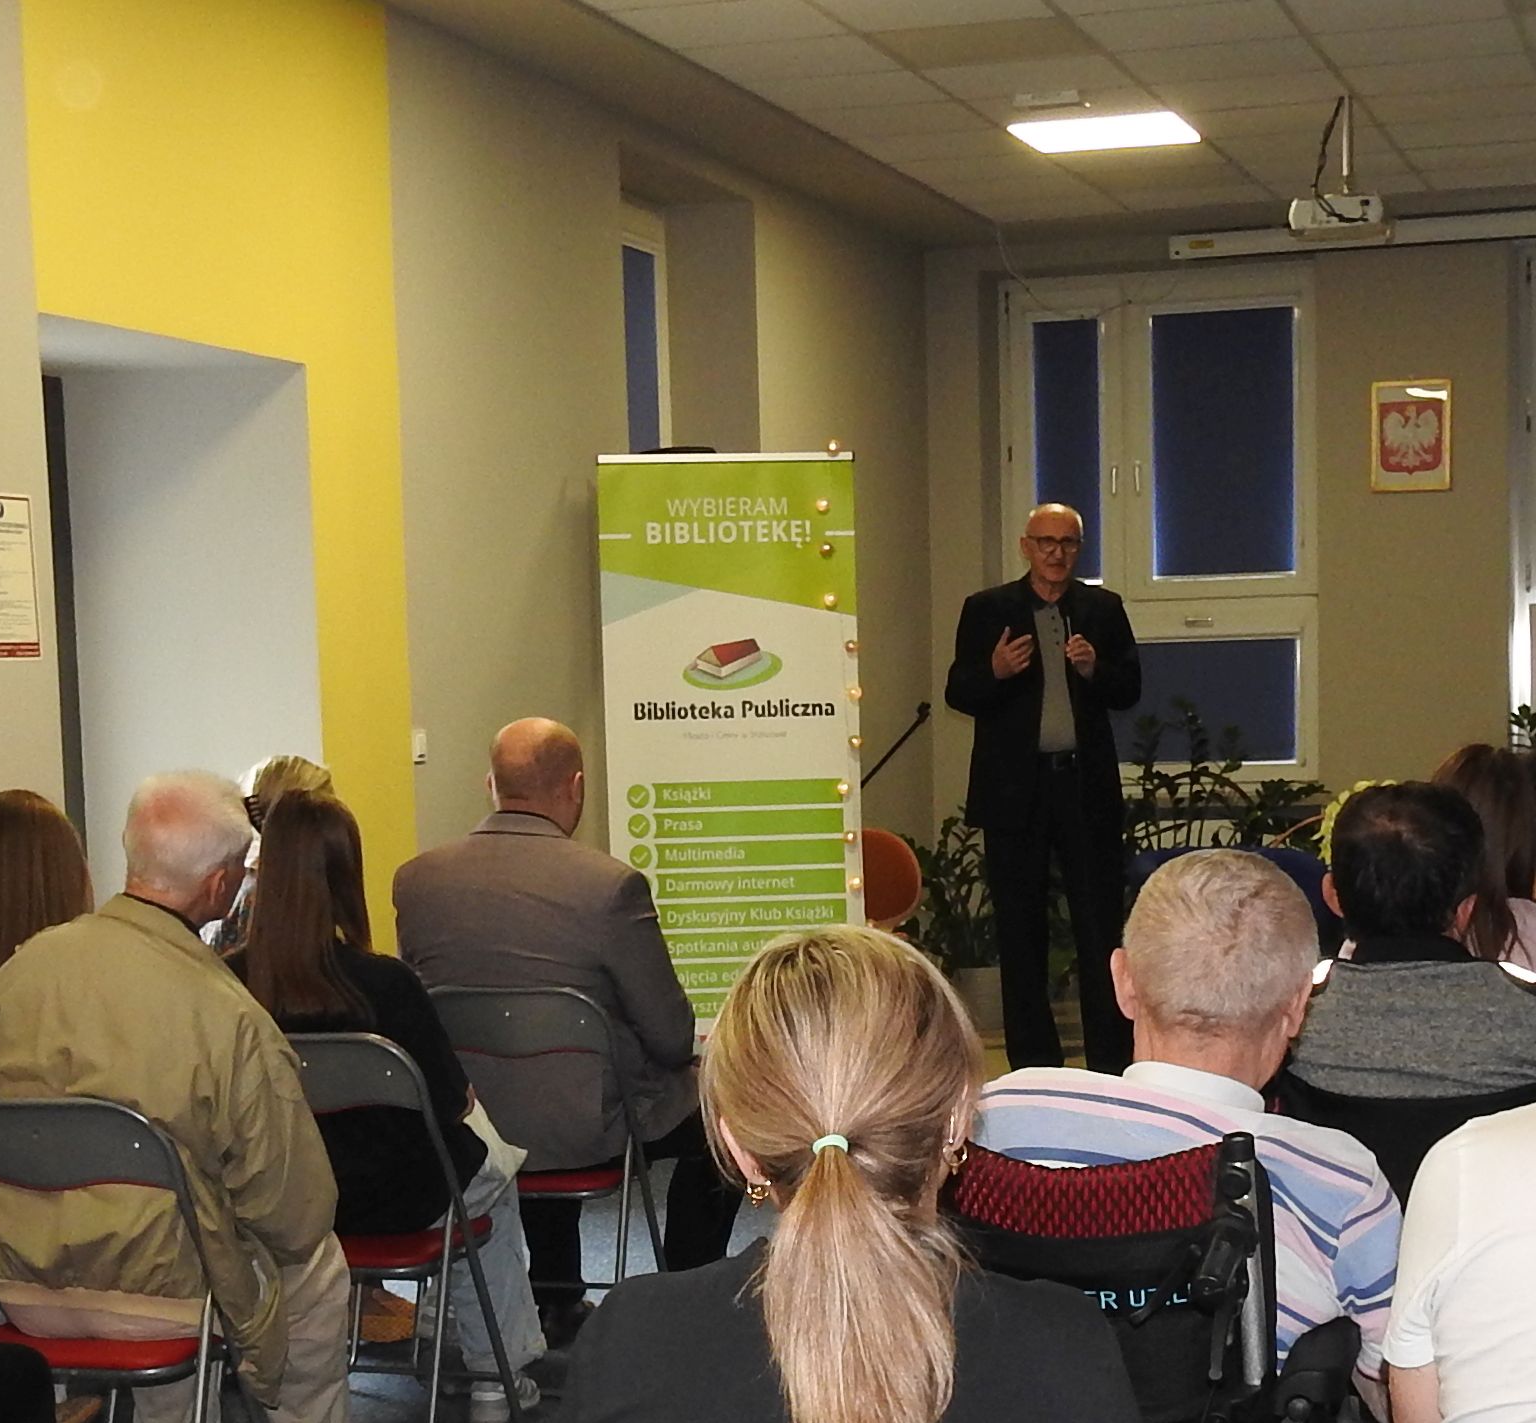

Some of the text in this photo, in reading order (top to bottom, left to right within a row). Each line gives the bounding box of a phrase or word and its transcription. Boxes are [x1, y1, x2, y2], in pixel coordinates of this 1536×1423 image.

[667, 497, 788, 517] WYBIERAM
[645, 520, 812, 548] BIBLIOTEKĘ!
[634, 698, 836, 721] Biblioteka Publiczna
[663, 788, 712, 804] Książki
[663, 818, 704, 832] Prasa
[665, 848, 746, 862] Multimedia
[666, 876, 796, 896] Darmowy internet
[667, 905, 834, 926] Dyskusyjny Klub Książki
[667, 940, 739, 956] Spotkania
[677, 970, 719, 987] ajęcia
